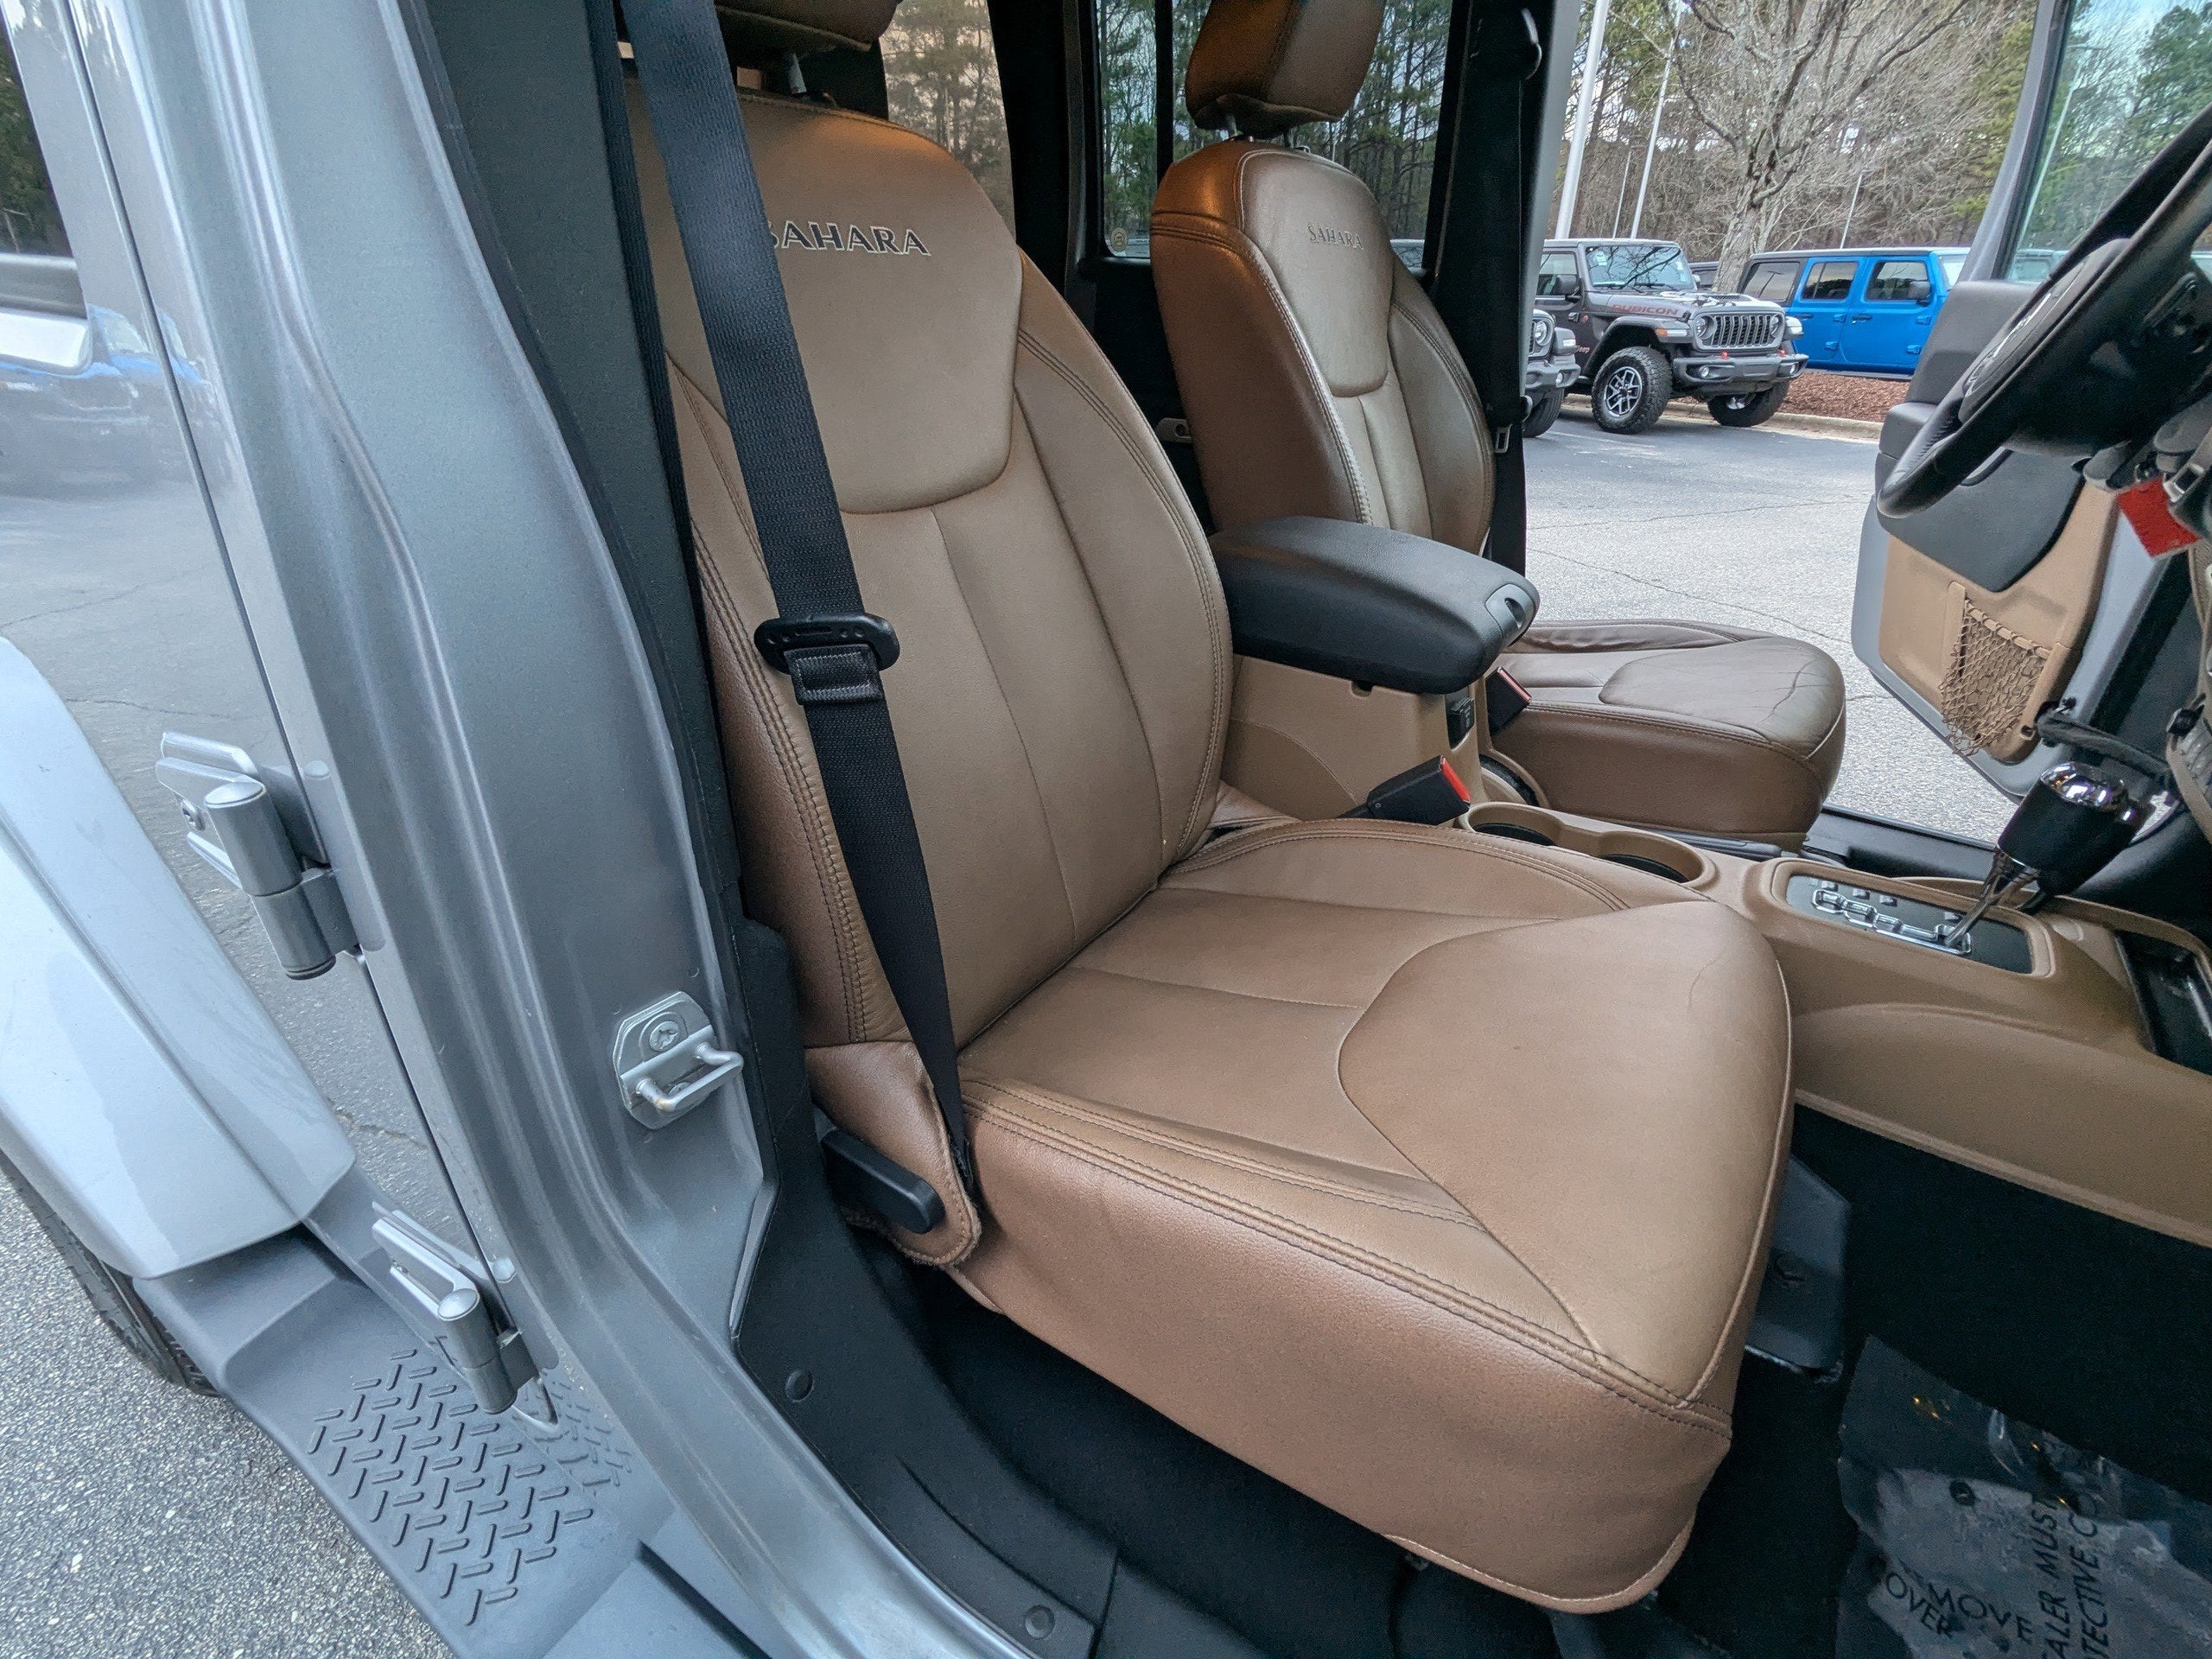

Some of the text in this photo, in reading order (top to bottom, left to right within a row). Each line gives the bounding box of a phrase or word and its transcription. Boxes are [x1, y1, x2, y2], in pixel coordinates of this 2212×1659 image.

[1306, 223, 1364, 251] SAHARA
[1612, 304, 1679, 316] RUBICON
[2037, 1590, 2071, 1659] ALER
[2069, 1544, 2110, 1659] TECTIVE
